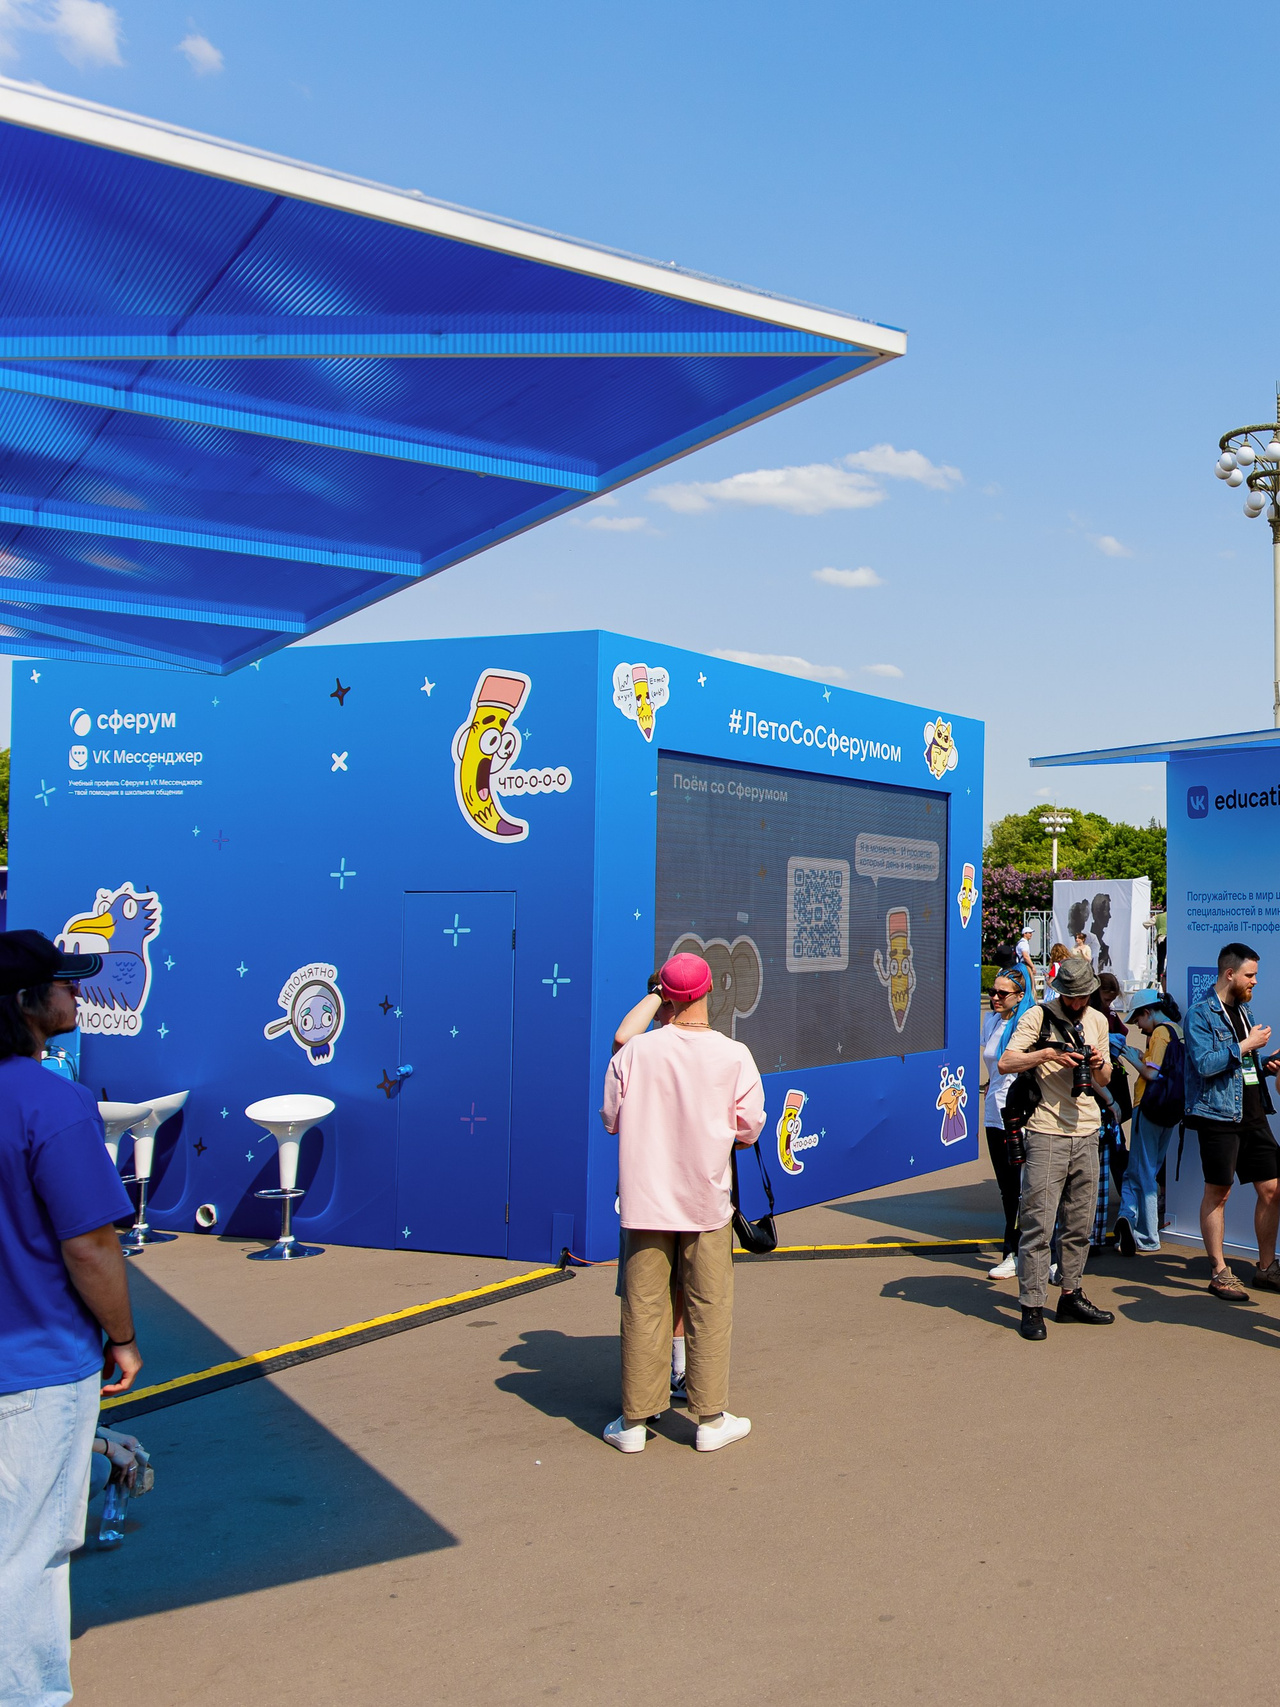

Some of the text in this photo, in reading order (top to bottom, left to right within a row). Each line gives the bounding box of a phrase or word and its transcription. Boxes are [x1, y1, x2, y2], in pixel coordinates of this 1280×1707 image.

[97, 709, 176, 734] сферум
[728, 708, 902, 763] #ЛетоСоСферумом
[92, 750, 203, 766] VK Мессенджер
[68, 779, 93, 787] Учебный
[120, 779, 144, 787] Сферум
[159, 779, 203, 787] Мессенджере
[498, 773, 566, 789] ЧТО-О-О-О
[673, 773, 788, 803] Поём со Сферумом
[1190, 795, 1206, 811] VK
[1187, 891, 1247, 904] Погружайтесь
[1249, 892, 1254, 900] в
[1256, 892, 1274, 902] мир
[1187, 906, 1256, 918] специальностей
[1258, 908, 1263, 916] в
[1187, 921, 1239, 933] «Тест-драйв
[281, 967, 334, 1006] НЕПОНЯТНО
[77, 1012, 138, 1030] ЛЮСУЮ
